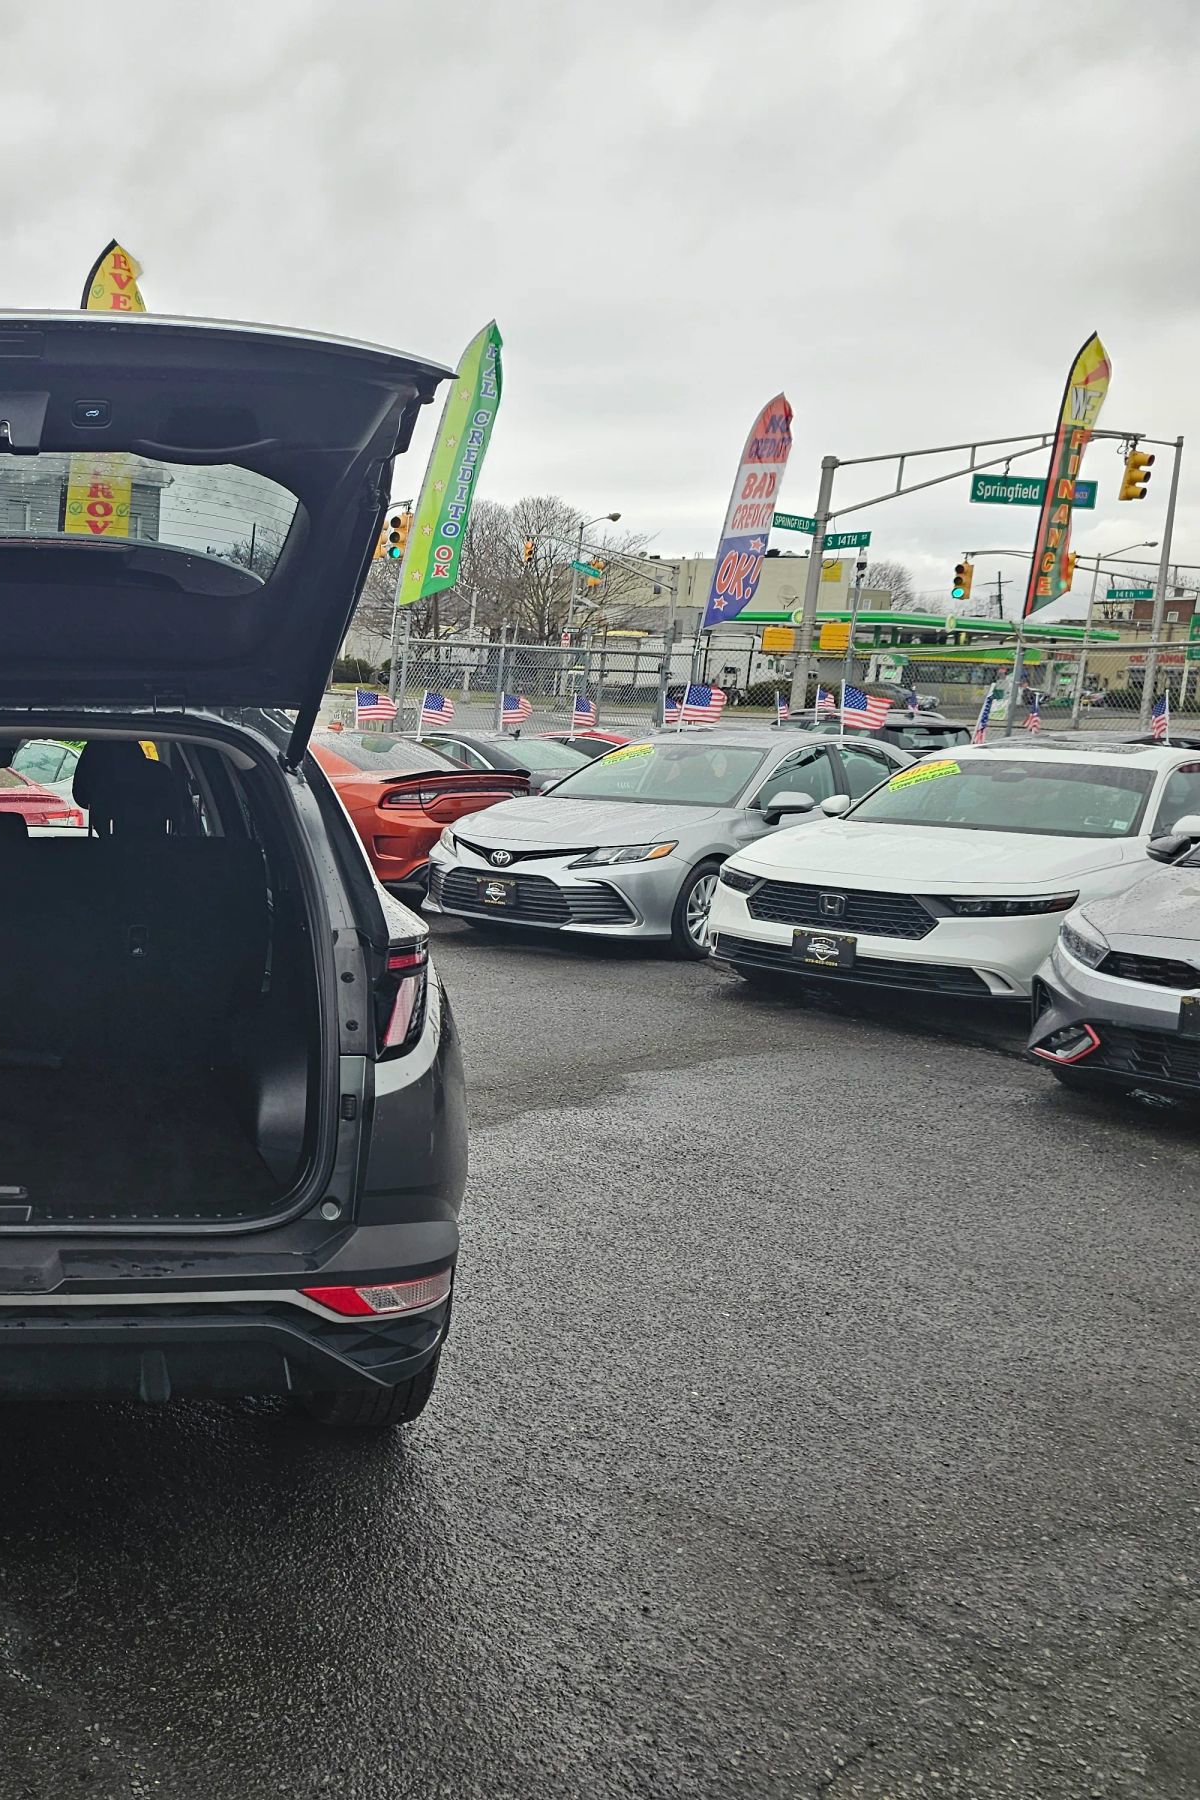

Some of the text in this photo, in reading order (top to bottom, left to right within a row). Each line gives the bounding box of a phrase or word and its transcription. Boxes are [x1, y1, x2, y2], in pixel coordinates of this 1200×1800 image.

[110, 253, 132, 311] EVE
[1070, 386, 1103, 424] WE
[441, 410, 492, 538] CREDITO
[741, 471, 777, 500] BAD
[976, 481, 1040, 502] Springfield
[85, 483, 114, 534] ROV
[774, 515, 810, 530] SPRINGFIELD
[1037, 429, 1087, 596] FINANCE
[827, 536, 833, 547] S
[837, 534, 858, 546] 14TH
[432, 545, 454, 578] OK
[716, 550, 765, 600] OK!
